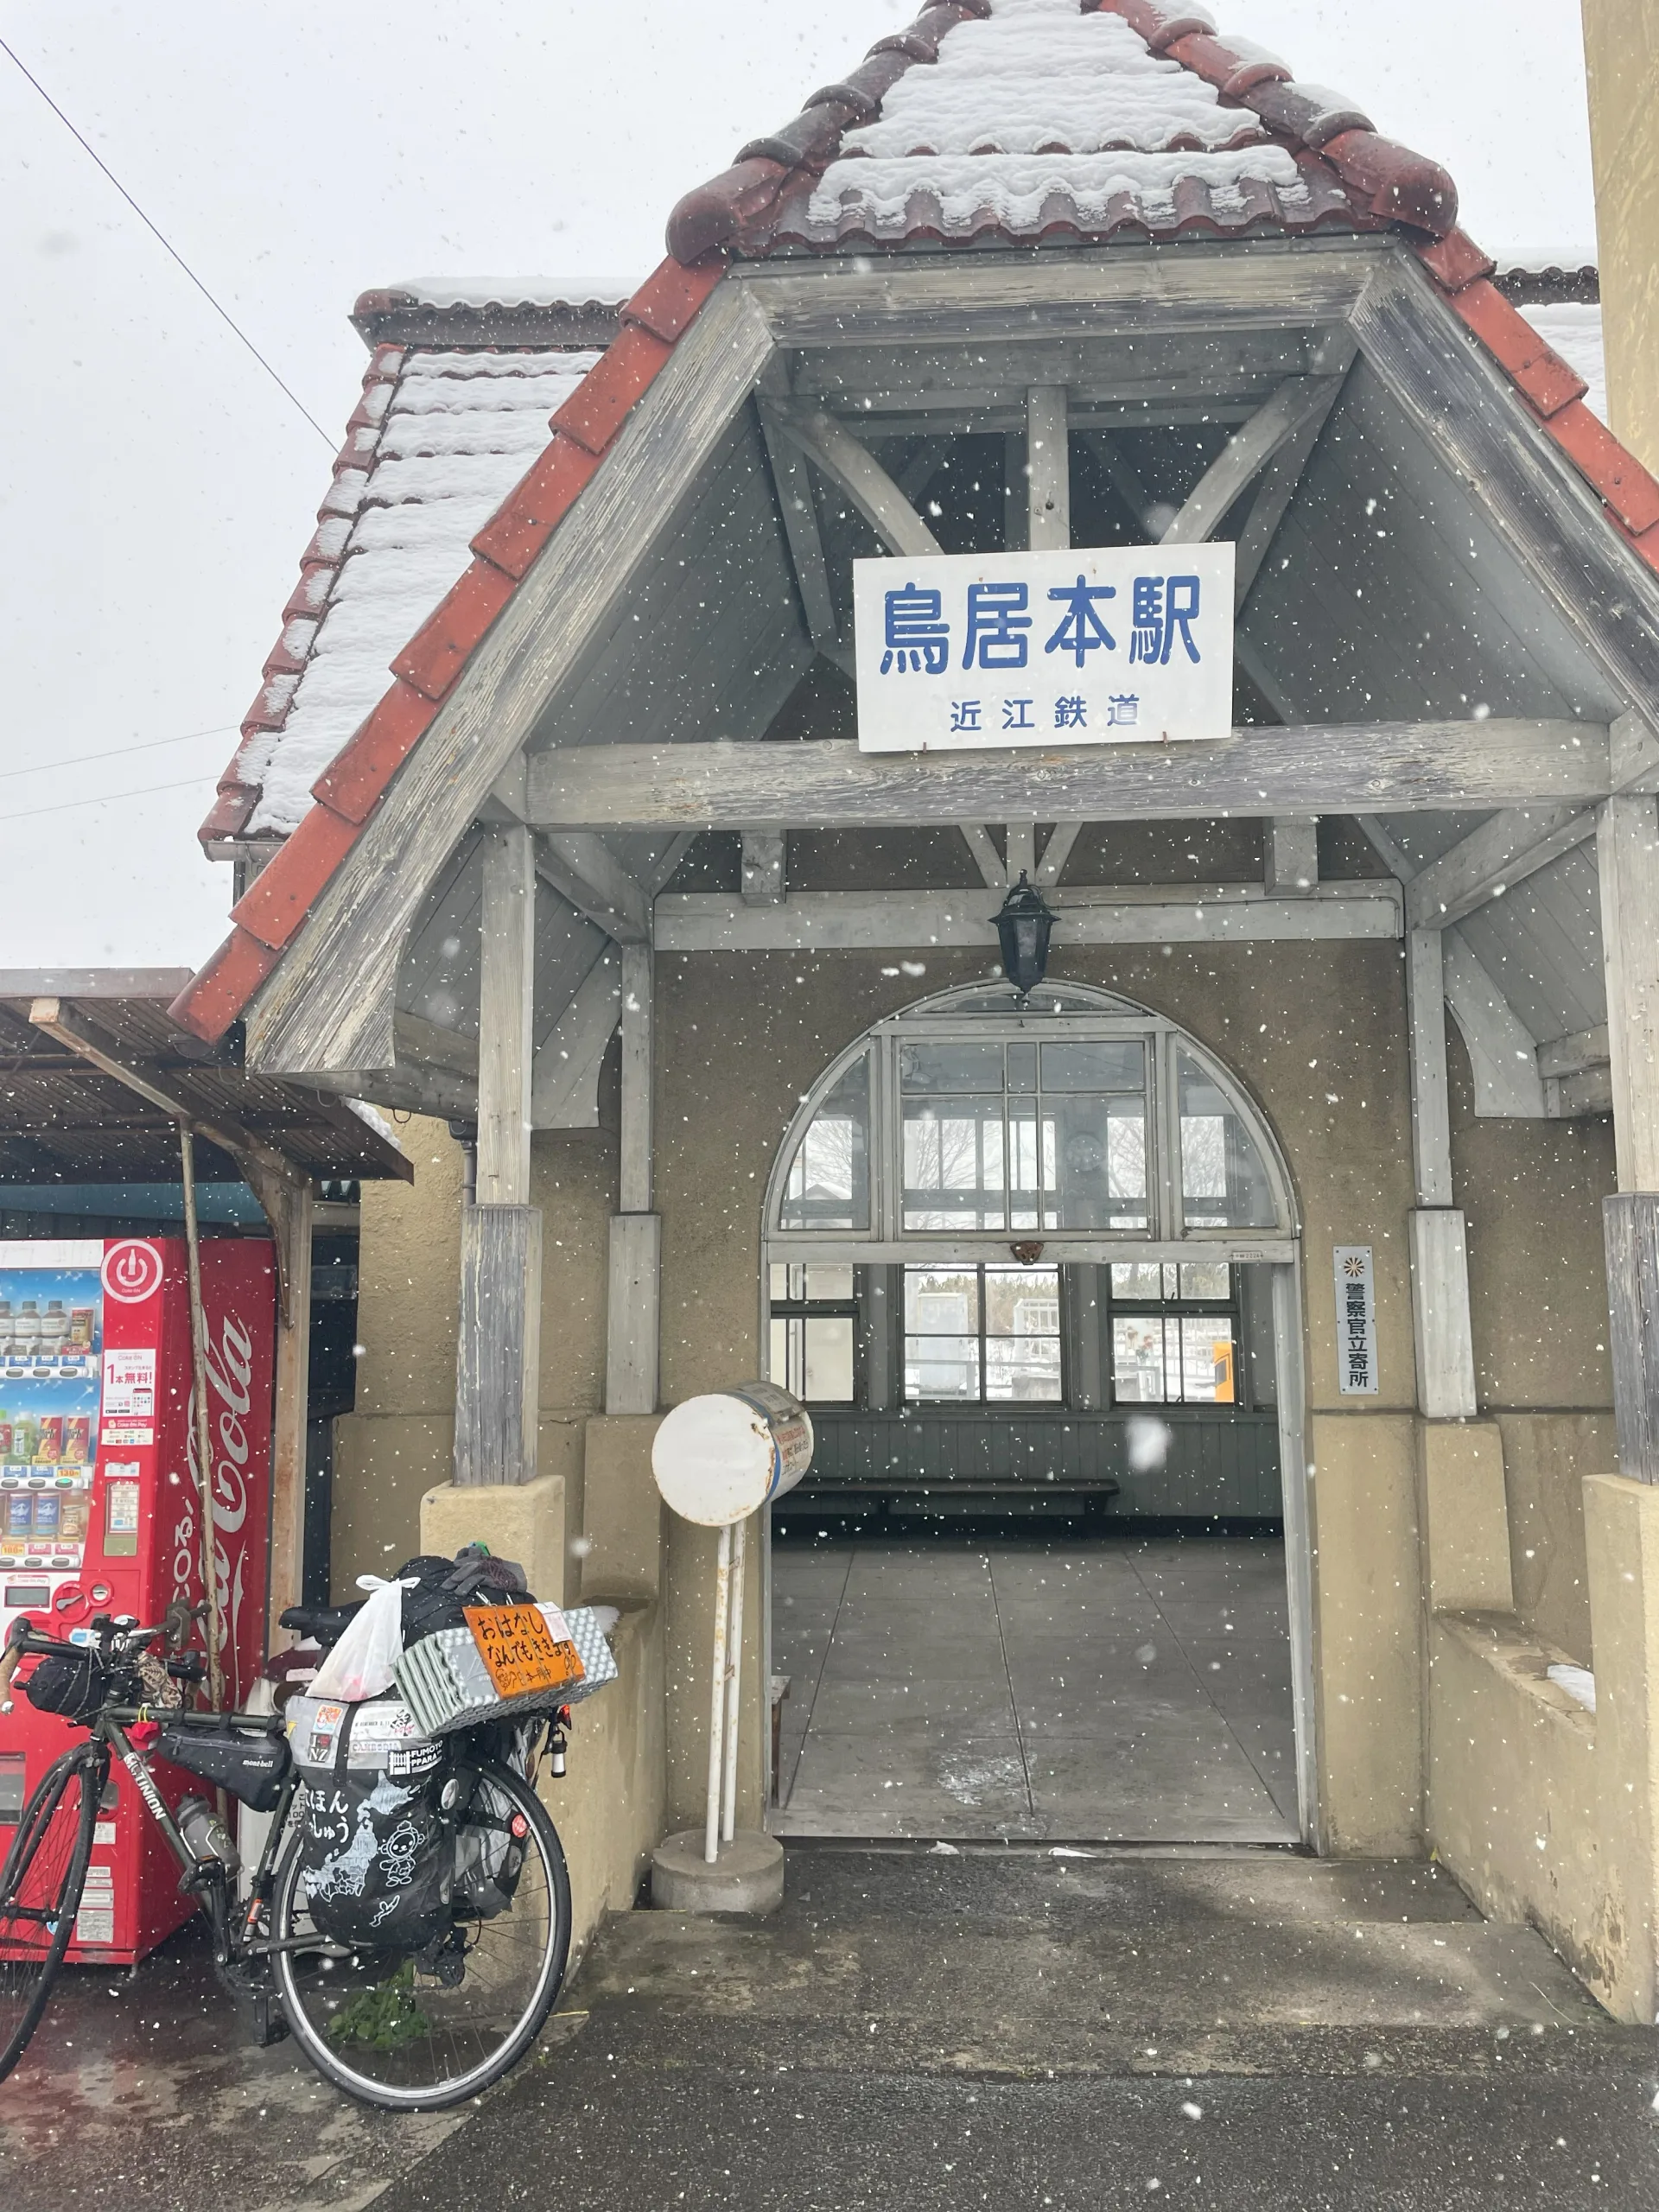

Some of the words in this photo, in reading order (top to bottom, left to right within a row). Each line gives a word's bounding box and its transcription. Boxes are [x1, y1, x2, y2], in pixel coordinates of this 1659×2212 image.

[880, 574, 1201, 675] 鳥居本駅
[950, 694, 1141, 733] 近江鉄道
[1345, 1283, 1369, 1388] 警察官立寄所
[478, 1611, 543, 1641] おはなし
[308, 1747, 328, 1762] NZ
[411, 1739, 443, 1758] FUMOTO
[309, 1814, 350, 1844] しゅう
